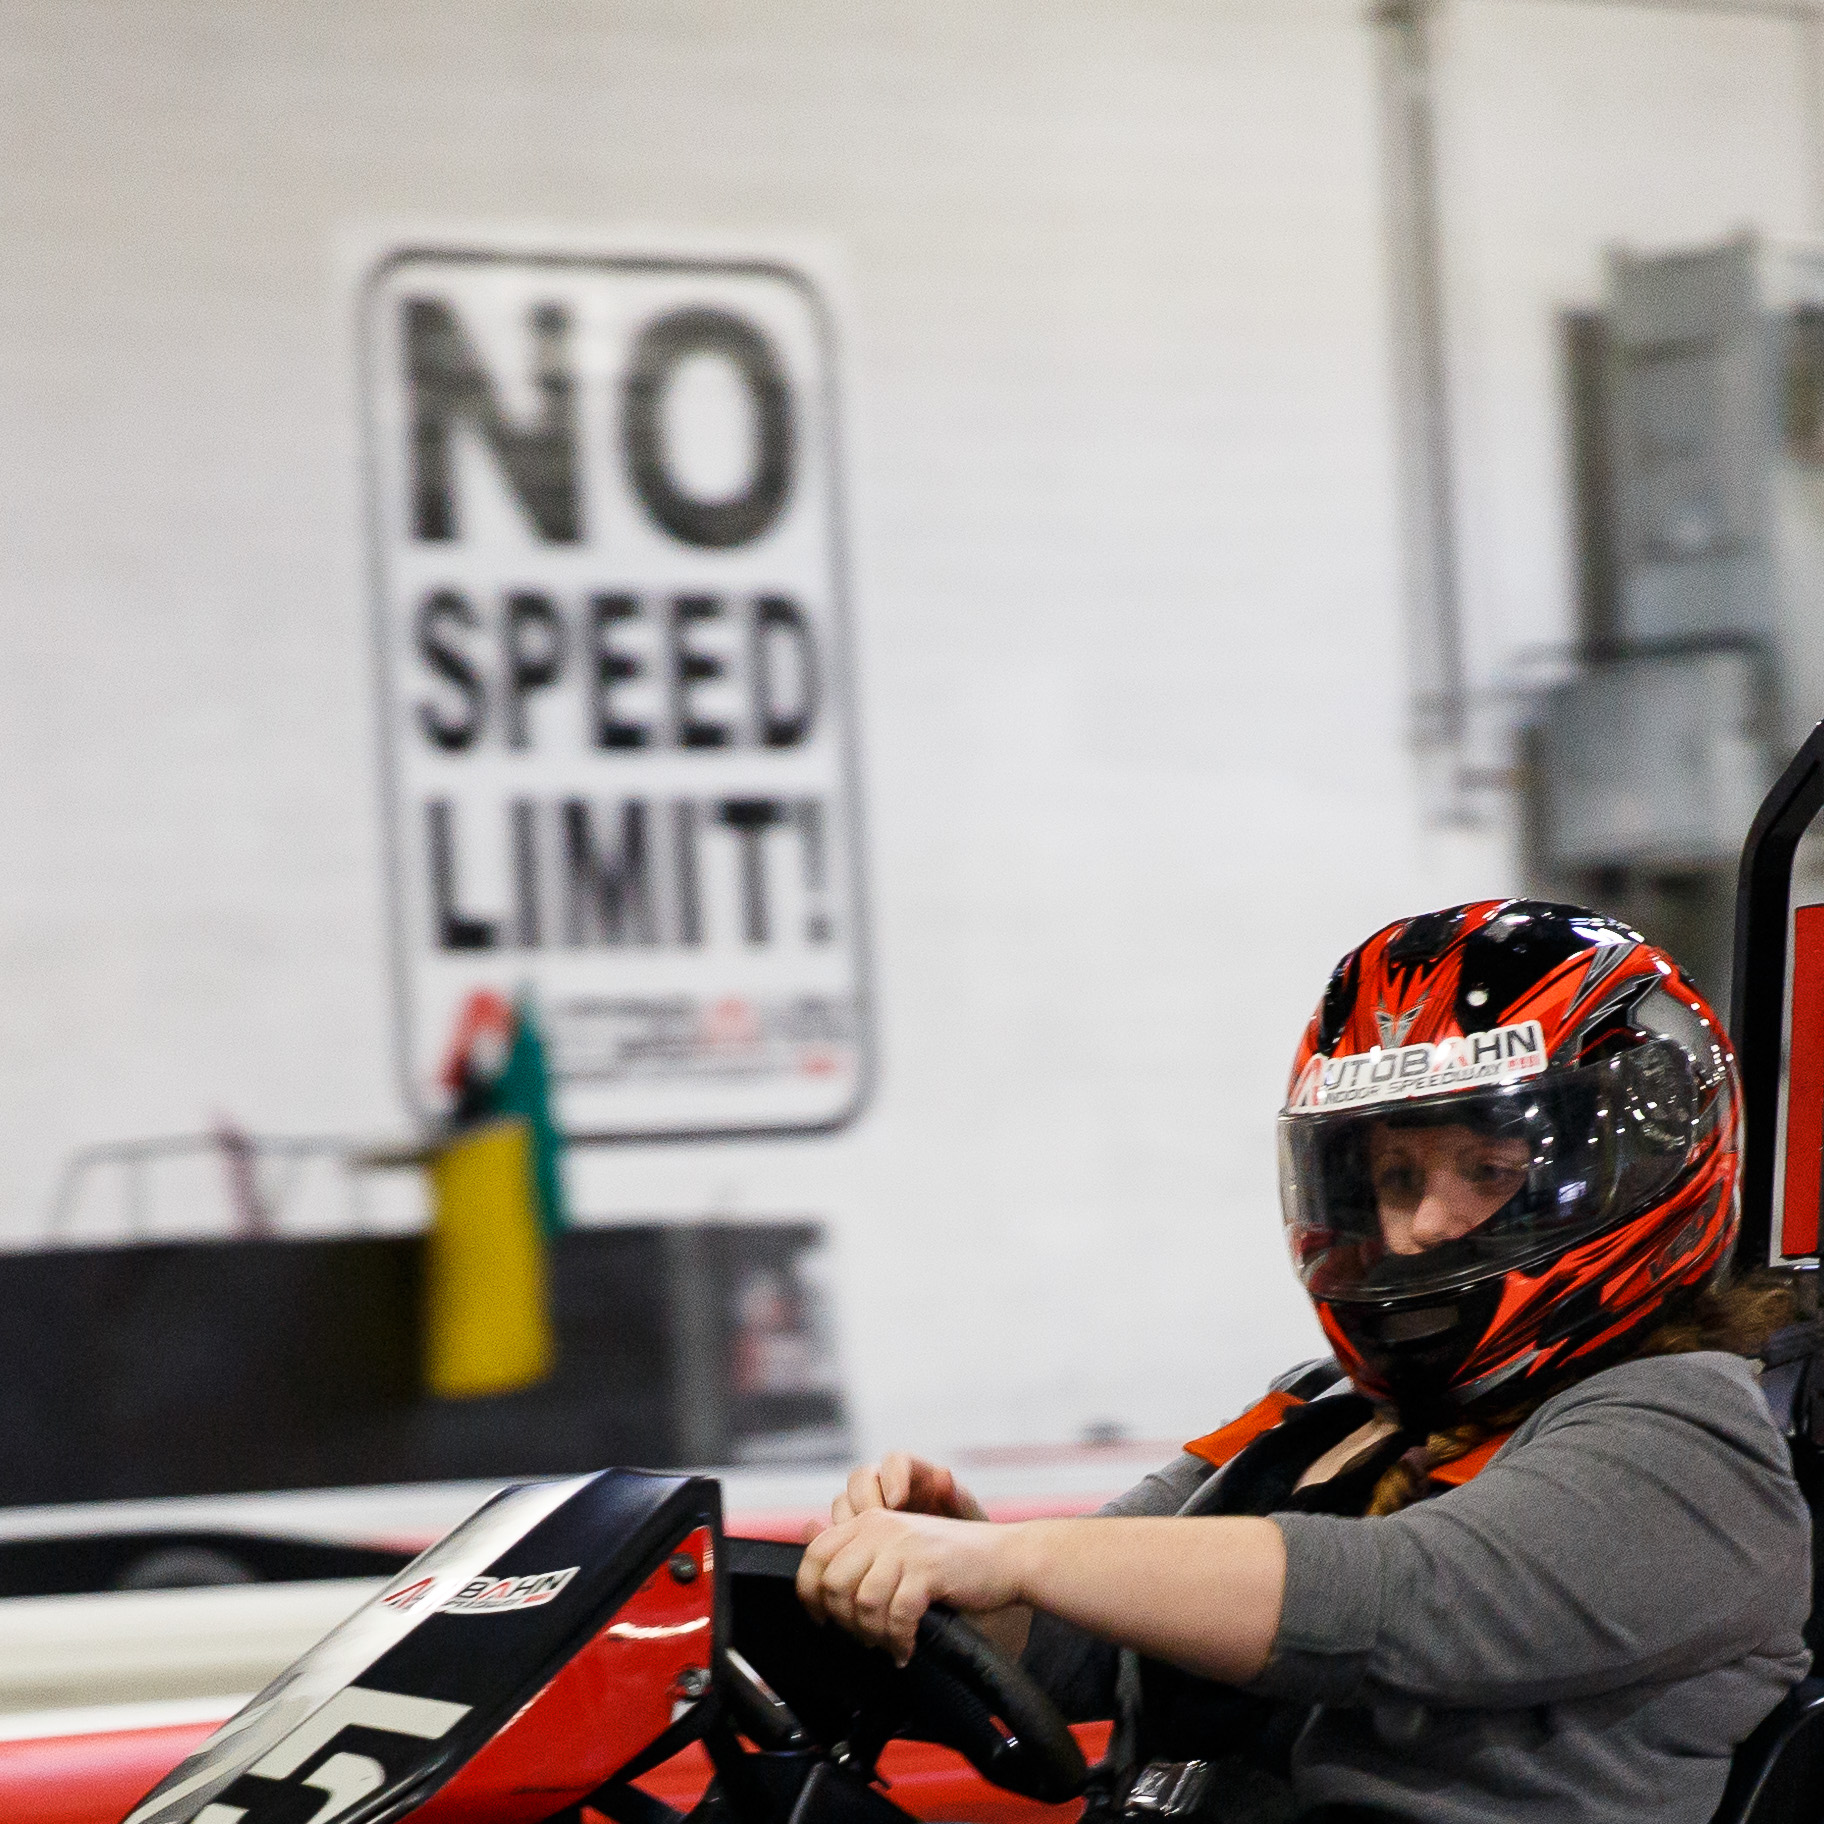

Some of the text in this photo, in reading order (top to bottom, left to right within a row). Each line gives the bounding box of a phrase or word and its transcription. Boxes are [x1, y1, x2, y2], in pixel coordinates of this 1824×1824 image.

[403, 296, 797, 547] NO
[415, 589, 820, 751] SPEED
[428, 797, 832, 950] LIMIT!
[1291, 1024, 1537, 1106] AUTOBAHN
[1324, 1084, 1380, 1104] NDOOR
[382, 1568, 578, 1609] ABAHN
